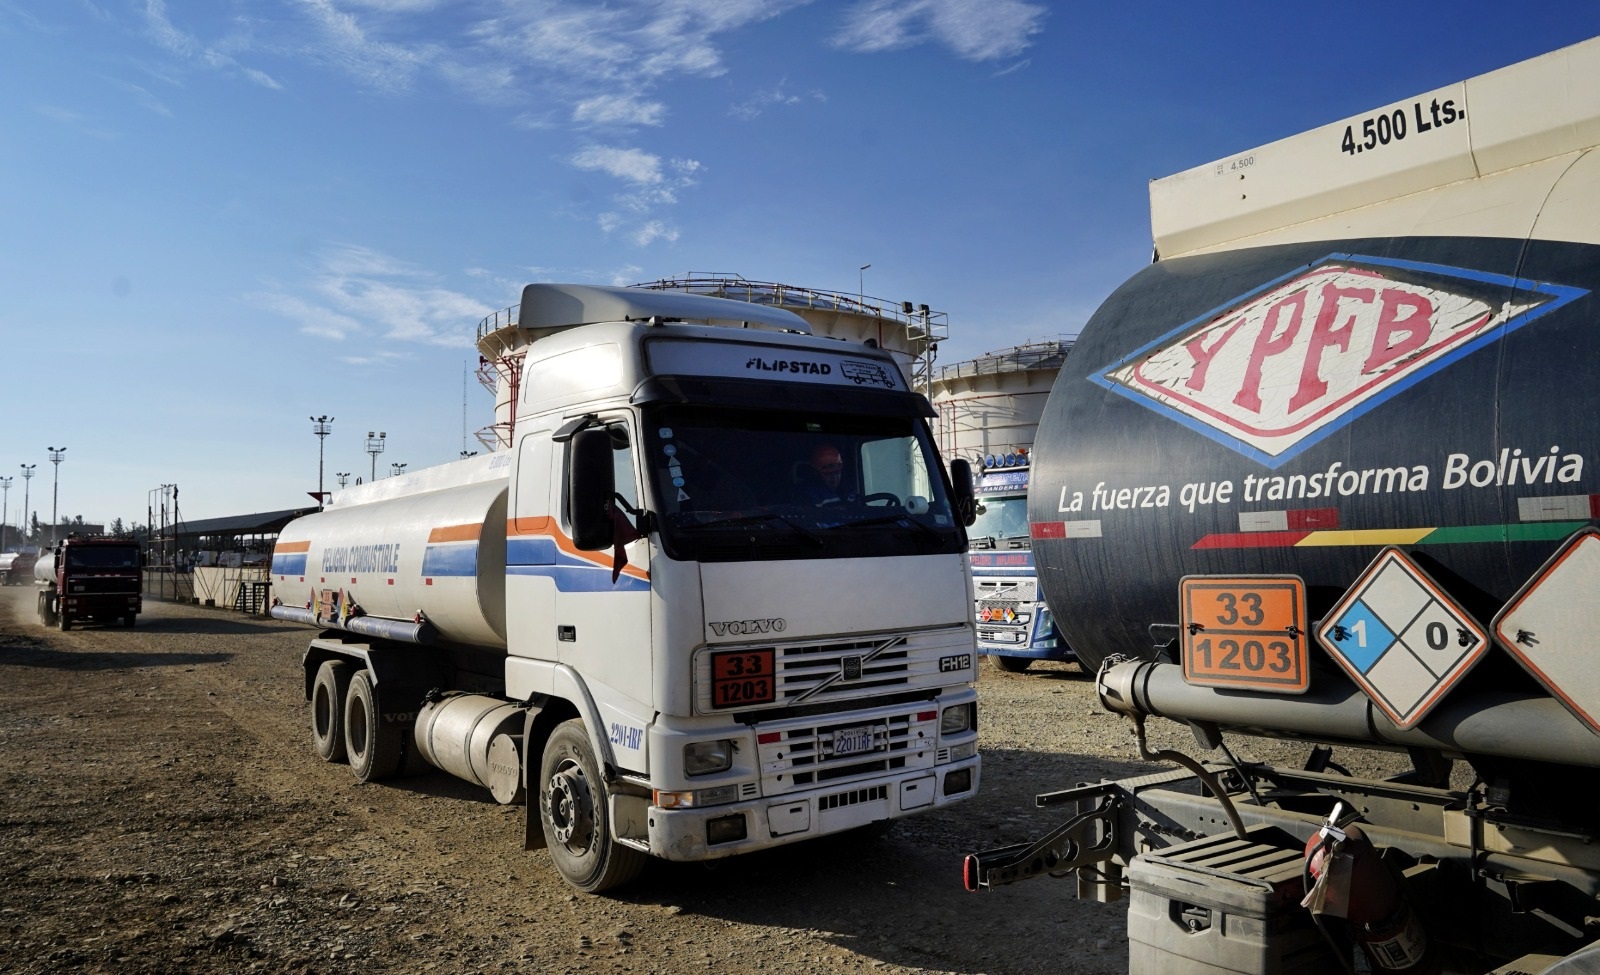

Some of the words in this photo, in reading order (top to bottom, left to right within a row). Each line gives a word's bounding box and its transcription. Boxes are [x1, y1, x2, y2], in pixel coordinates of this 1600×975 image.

[1341, 108, 1407, 155] 4.500
[1414, 97, 1465, 133] Lts.
[1230, 156, 1254, 170] 4.500
[1185, 282, 1436, 415] YPFB
[1058, 486, 1083, 513] La
[1092, 482, 1170, 511] fuerza
[1180, 480, 1233, 513] que
[1243, 461, 1429, 502] transforma
[1443, 445, 1584, 490] Bolivia
[322, 547, 348, 573] PELIGRO
[348, 543, 400, 573] COMBUSTIBLE
[1216, 592, 1265, 627] 33
[708, 617, 786, 637] VOLVO
[1351, 619, 1367, 648] 1
[1425, 621, 1449, 651] 0
[726, 655, 762, 677] 33
[941, 654, 970, 672] FH12
[1196, 638, 1291, 673] 1203
[720, 680, 768, 702] 1203
[383, 711, 416, 723] VOL
[610, 722, 644, 751] 2201-IRF
[491, 762, 518, 777] VOLVO
